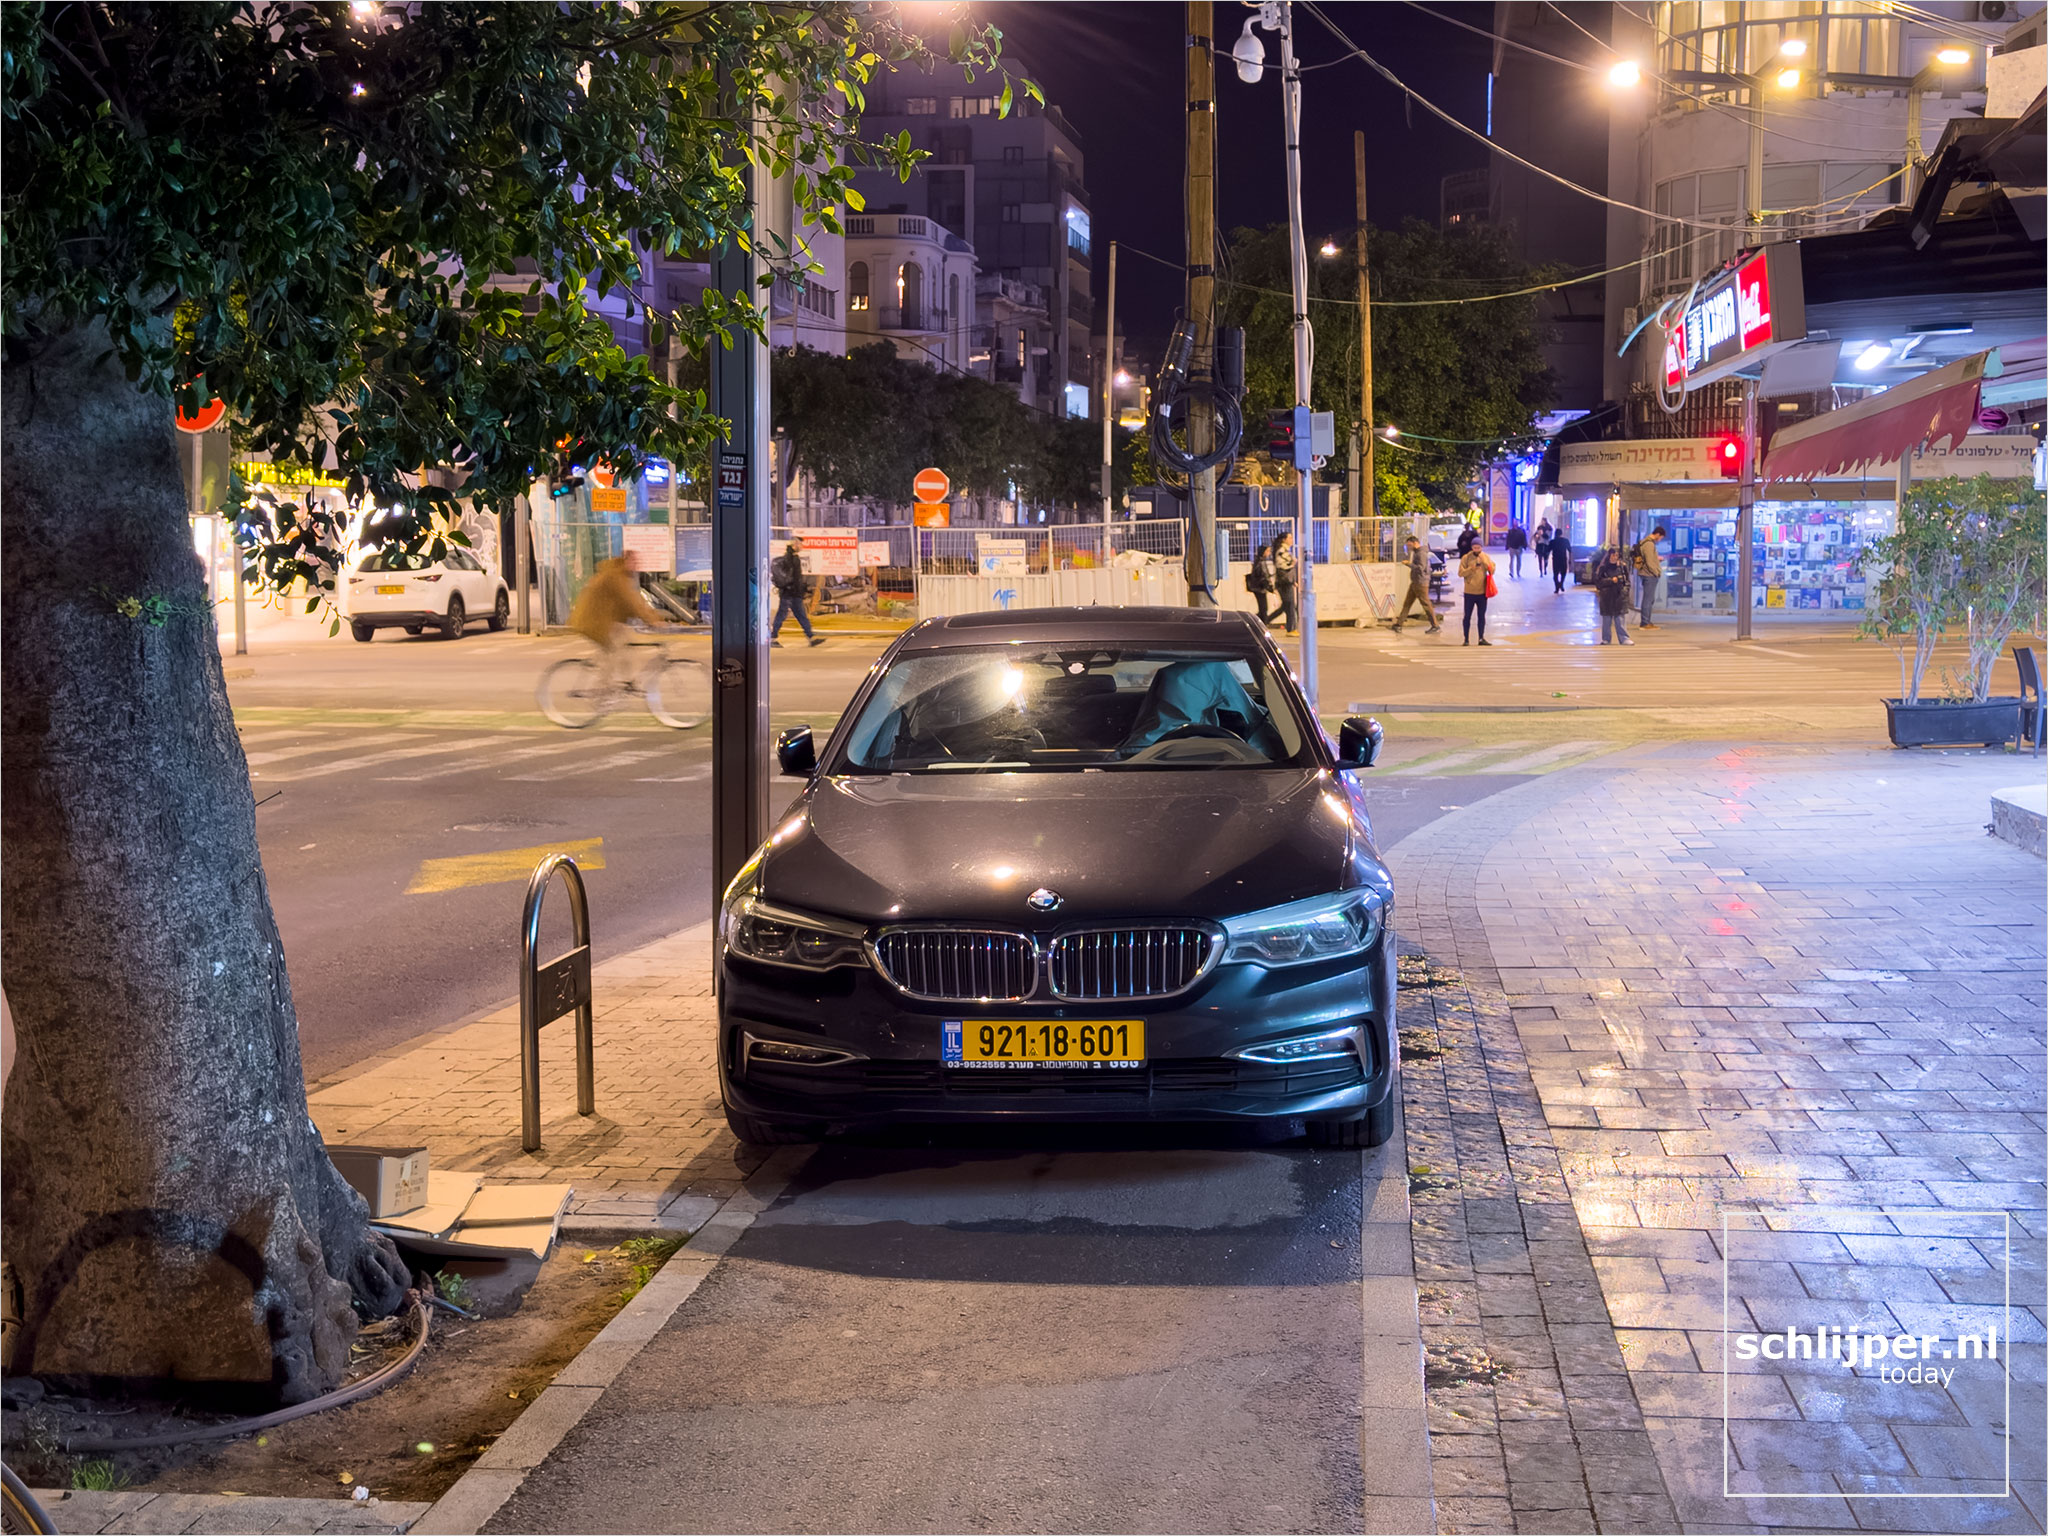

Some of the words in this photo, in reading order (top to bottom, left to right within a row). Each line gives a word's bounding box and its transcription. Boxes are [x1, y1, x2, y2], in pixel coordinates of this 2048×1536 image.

[1599, 450, 1622, 461] חשמל
[1626, 446, 1695, 463] במדינה
[1956, 445, 2003, 457] טלפונים
[722, 455, 744, 465] נתניהו
[722, 471, 742, 484] נגד
[720, 490, 743, 501] ישראל
[948, 1032, 960, 1048] IL
[947, 1060, 1006, 1069] 03-9522555
[1008, 1060, 1034, 1068] מערב
